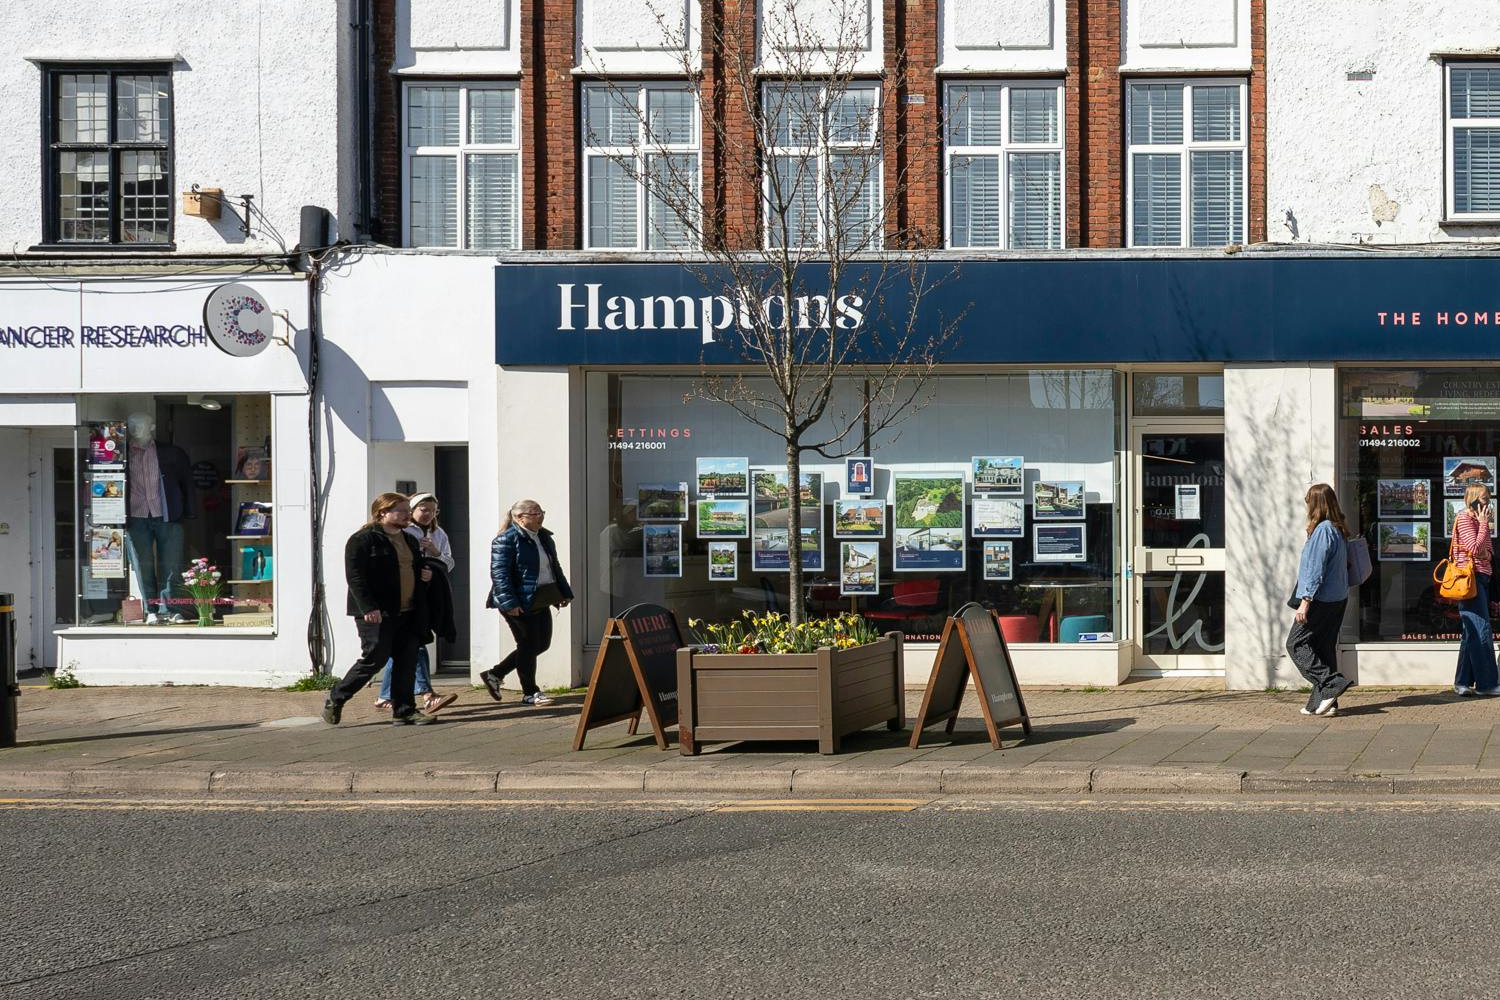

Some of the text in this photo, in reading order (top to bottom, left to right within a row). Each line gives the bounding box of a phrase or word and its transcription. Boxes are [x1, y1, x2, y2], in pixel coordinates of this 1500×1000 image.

[556, 282, 865, 345] Hamptons
[1377, 312, 1421, 326] THE
[81, 325, 205, 346] RESEARCH
[609, 428, 691, 438] ETTINGS
[1359, 425, 1413, 435] SALES
[635, 441, 666, 450] 216001
[1359, 439, 1421, 447] 01494 216002
